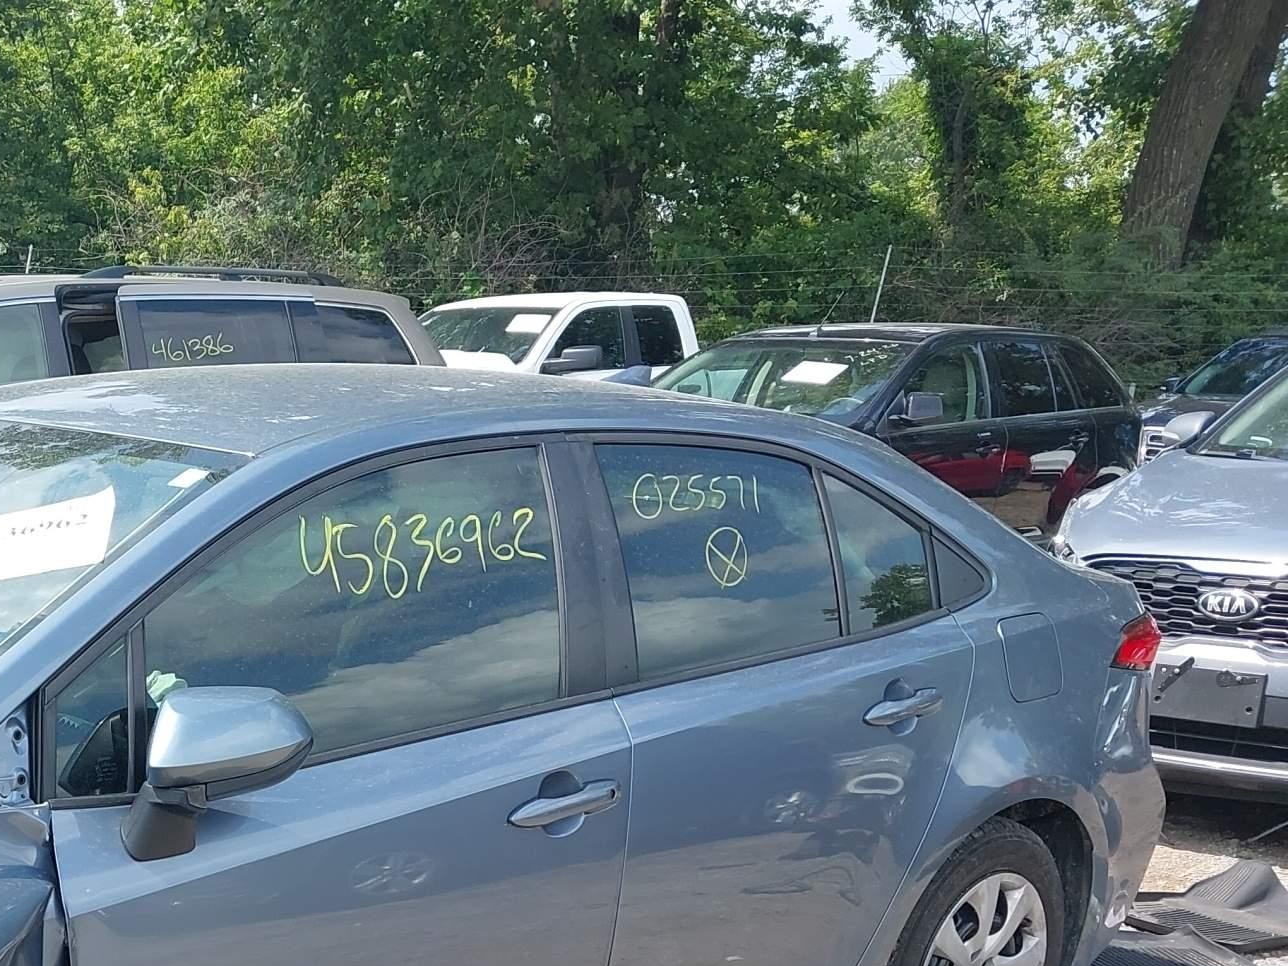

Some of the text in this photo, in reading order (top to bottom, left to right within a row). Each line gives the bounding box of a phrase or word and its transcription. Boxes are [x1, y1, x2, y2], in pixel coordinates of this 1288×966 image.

[152, 331, 234, 361] 461386
[632, 473, 760, 520] 025571
[298, 507, 547, 600] 45836962
[1206, 592, 1247, 614] KIA
